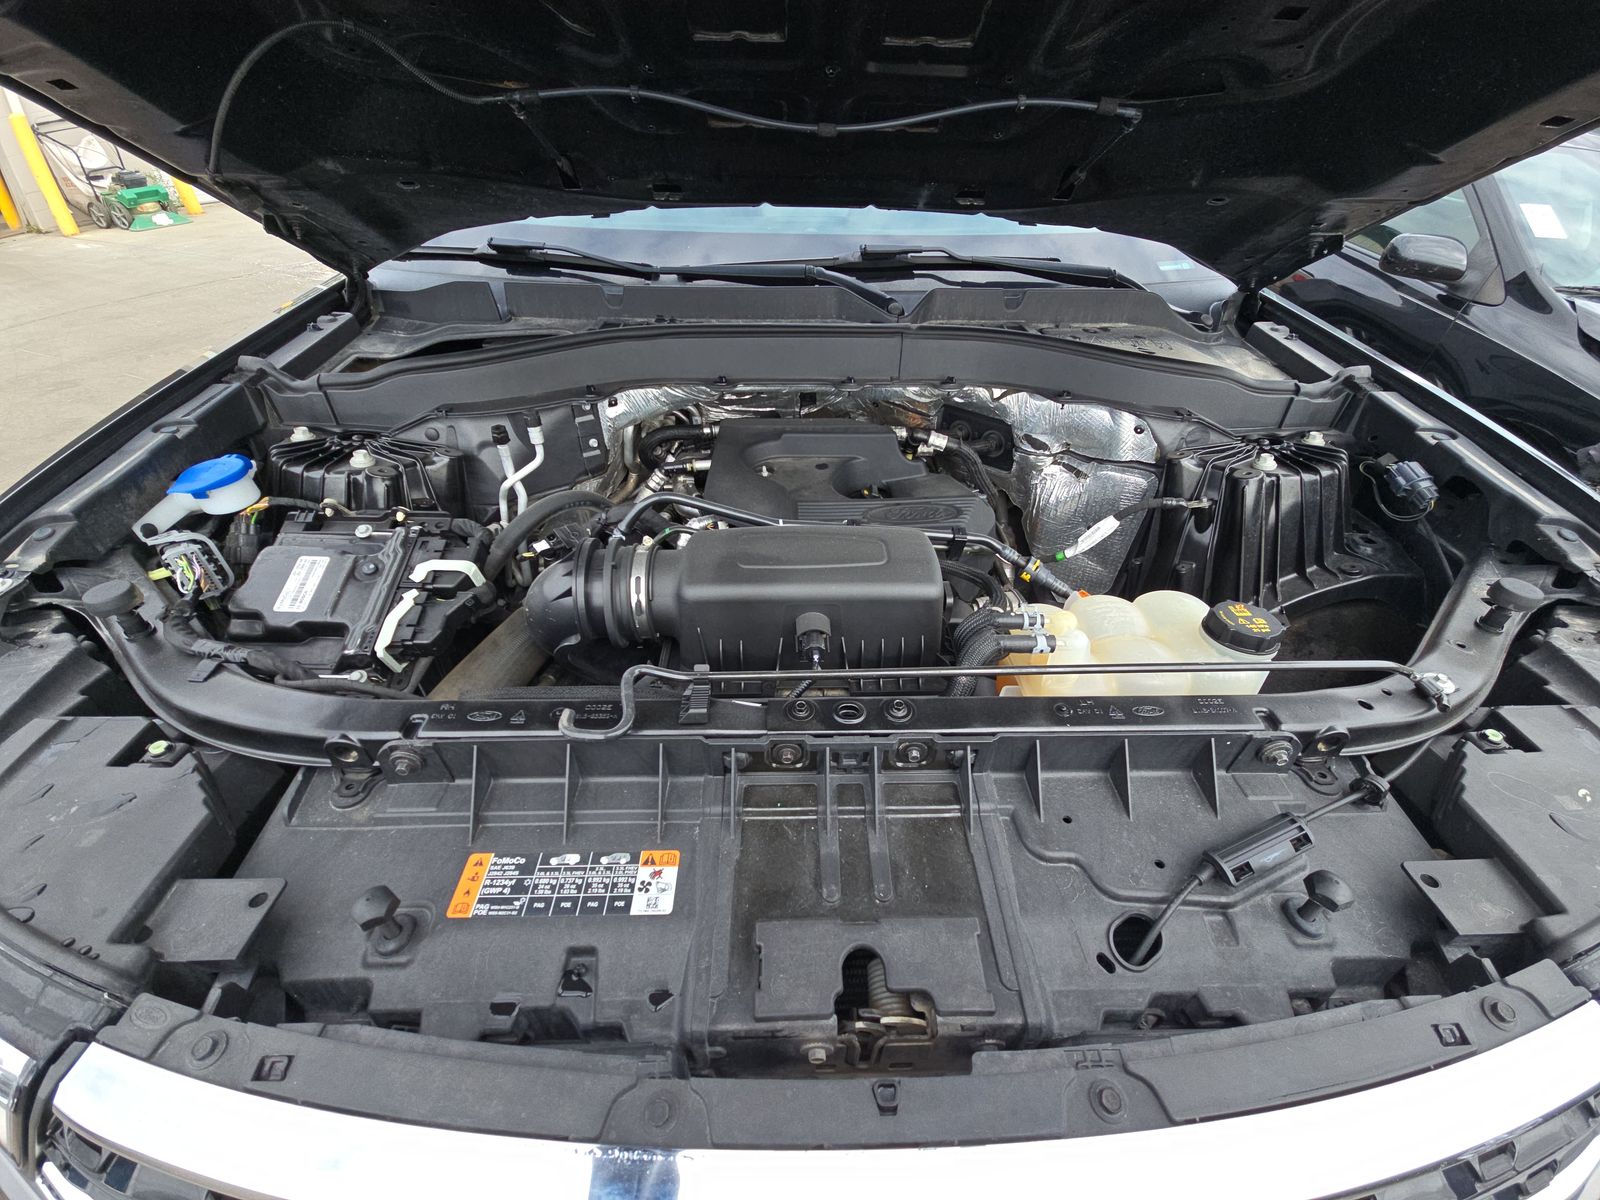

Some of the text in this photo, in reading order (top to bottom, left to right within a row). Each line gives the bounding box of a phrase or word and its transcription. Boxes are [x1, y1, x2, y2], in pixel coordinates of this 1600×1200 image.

[491, 856, 526, 865] FoMoCo
[484, 879, 517, 887] R-1234yf
[575, 877, 583, 885] kg
[628, 876, 636, 884] kg
[481, 887, 511, 895] (GWP 4)
